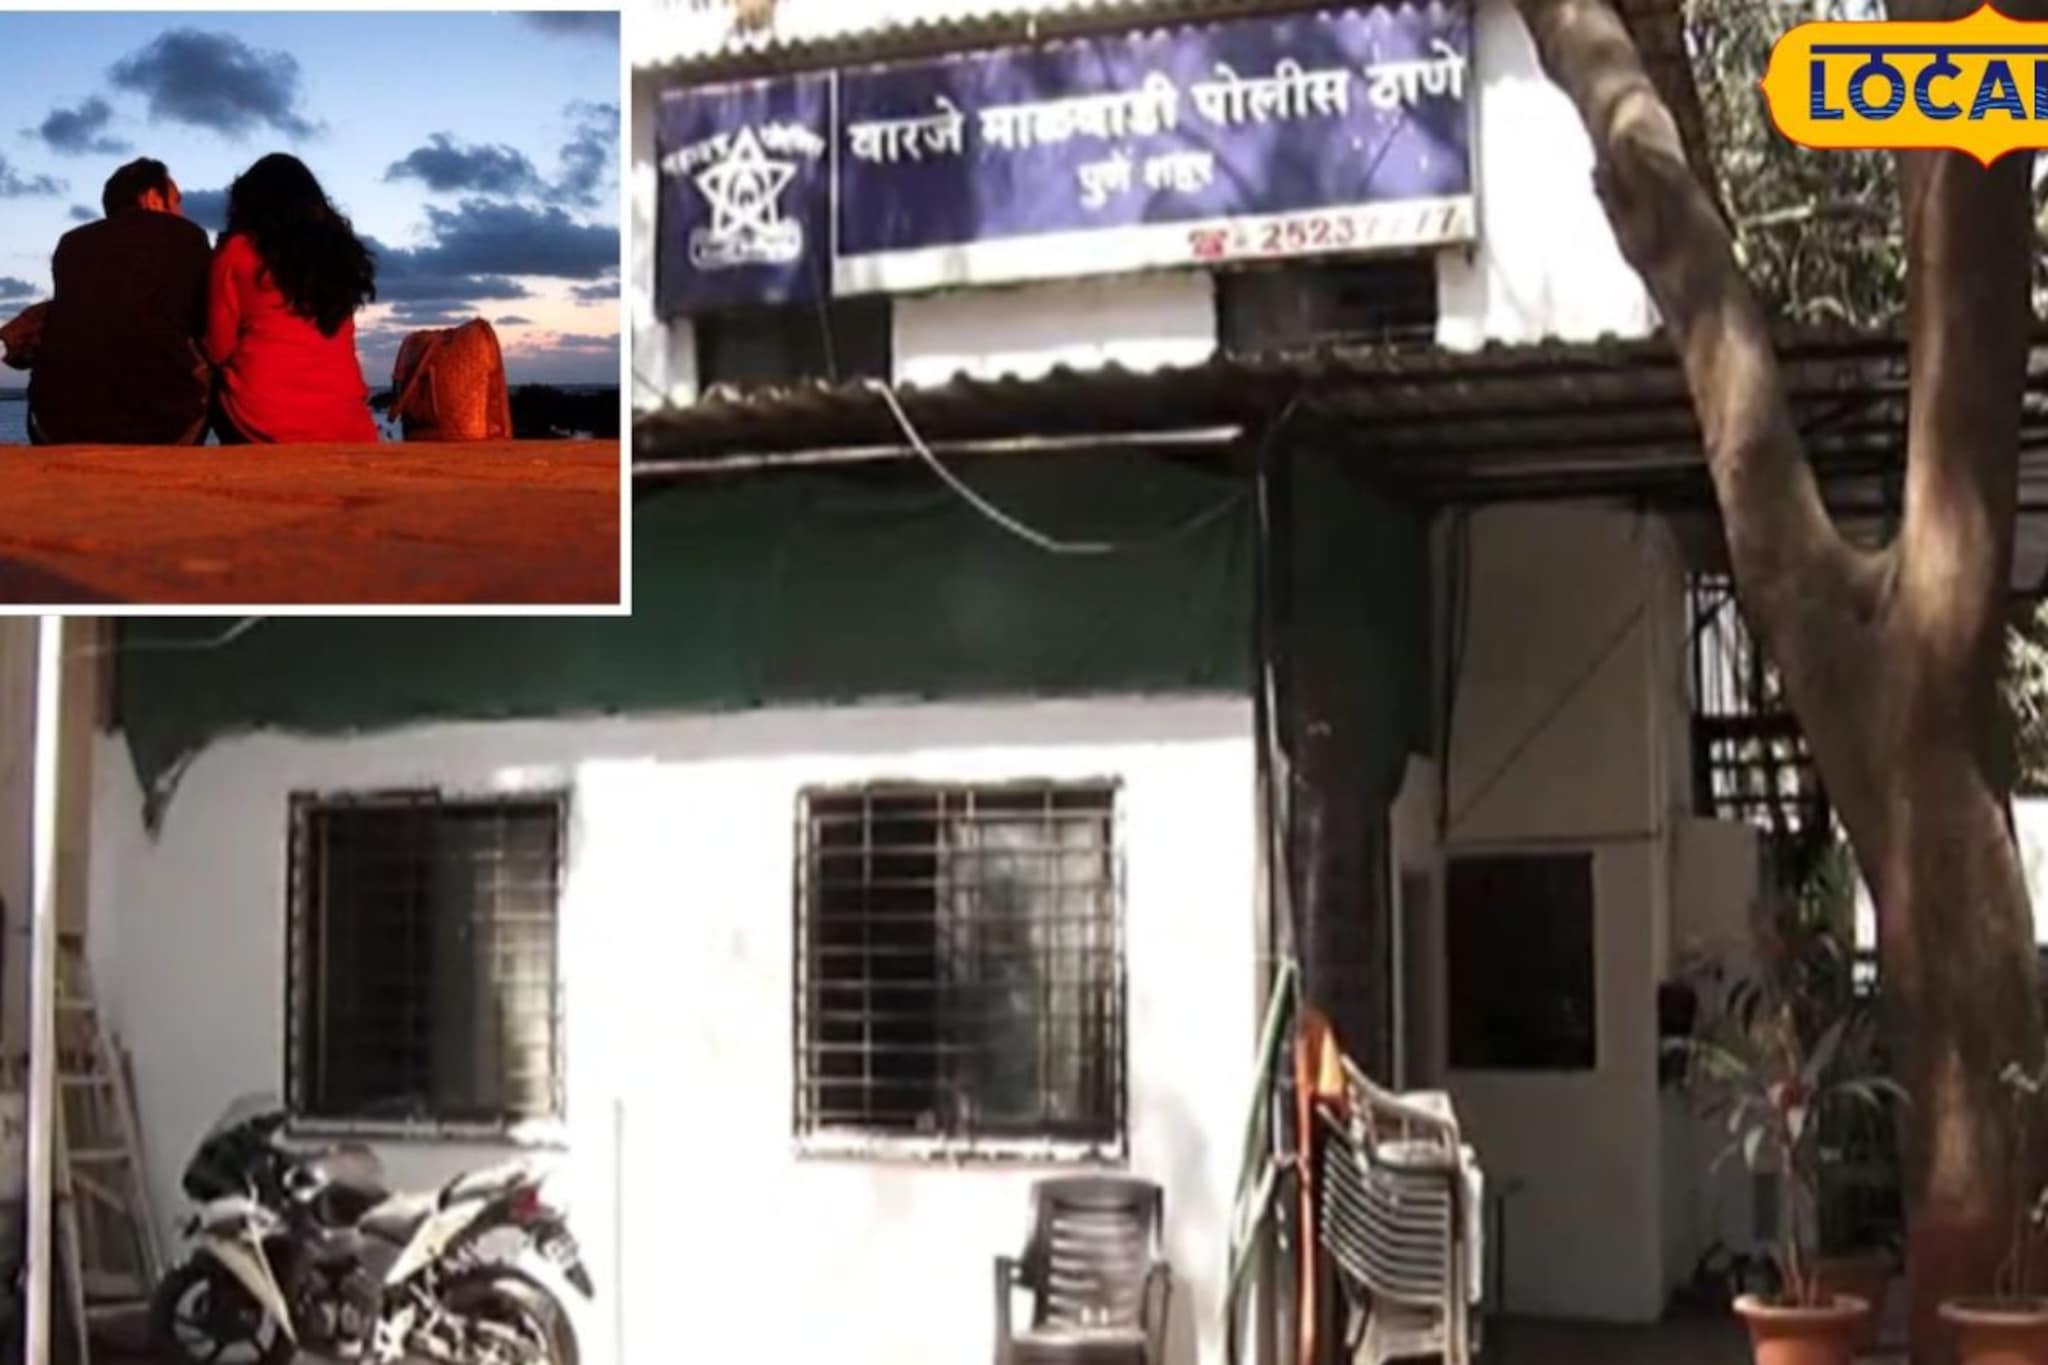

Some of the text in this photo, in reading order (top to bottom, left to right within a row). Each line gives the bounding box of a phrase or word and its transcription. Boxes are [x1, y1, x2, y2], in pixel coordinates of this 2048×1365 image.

[848, 95, 966, 164] वारजे
[1190, 57, 1350, 126] पोलीस
[1365, 38, 1468, 112] ठाणे
